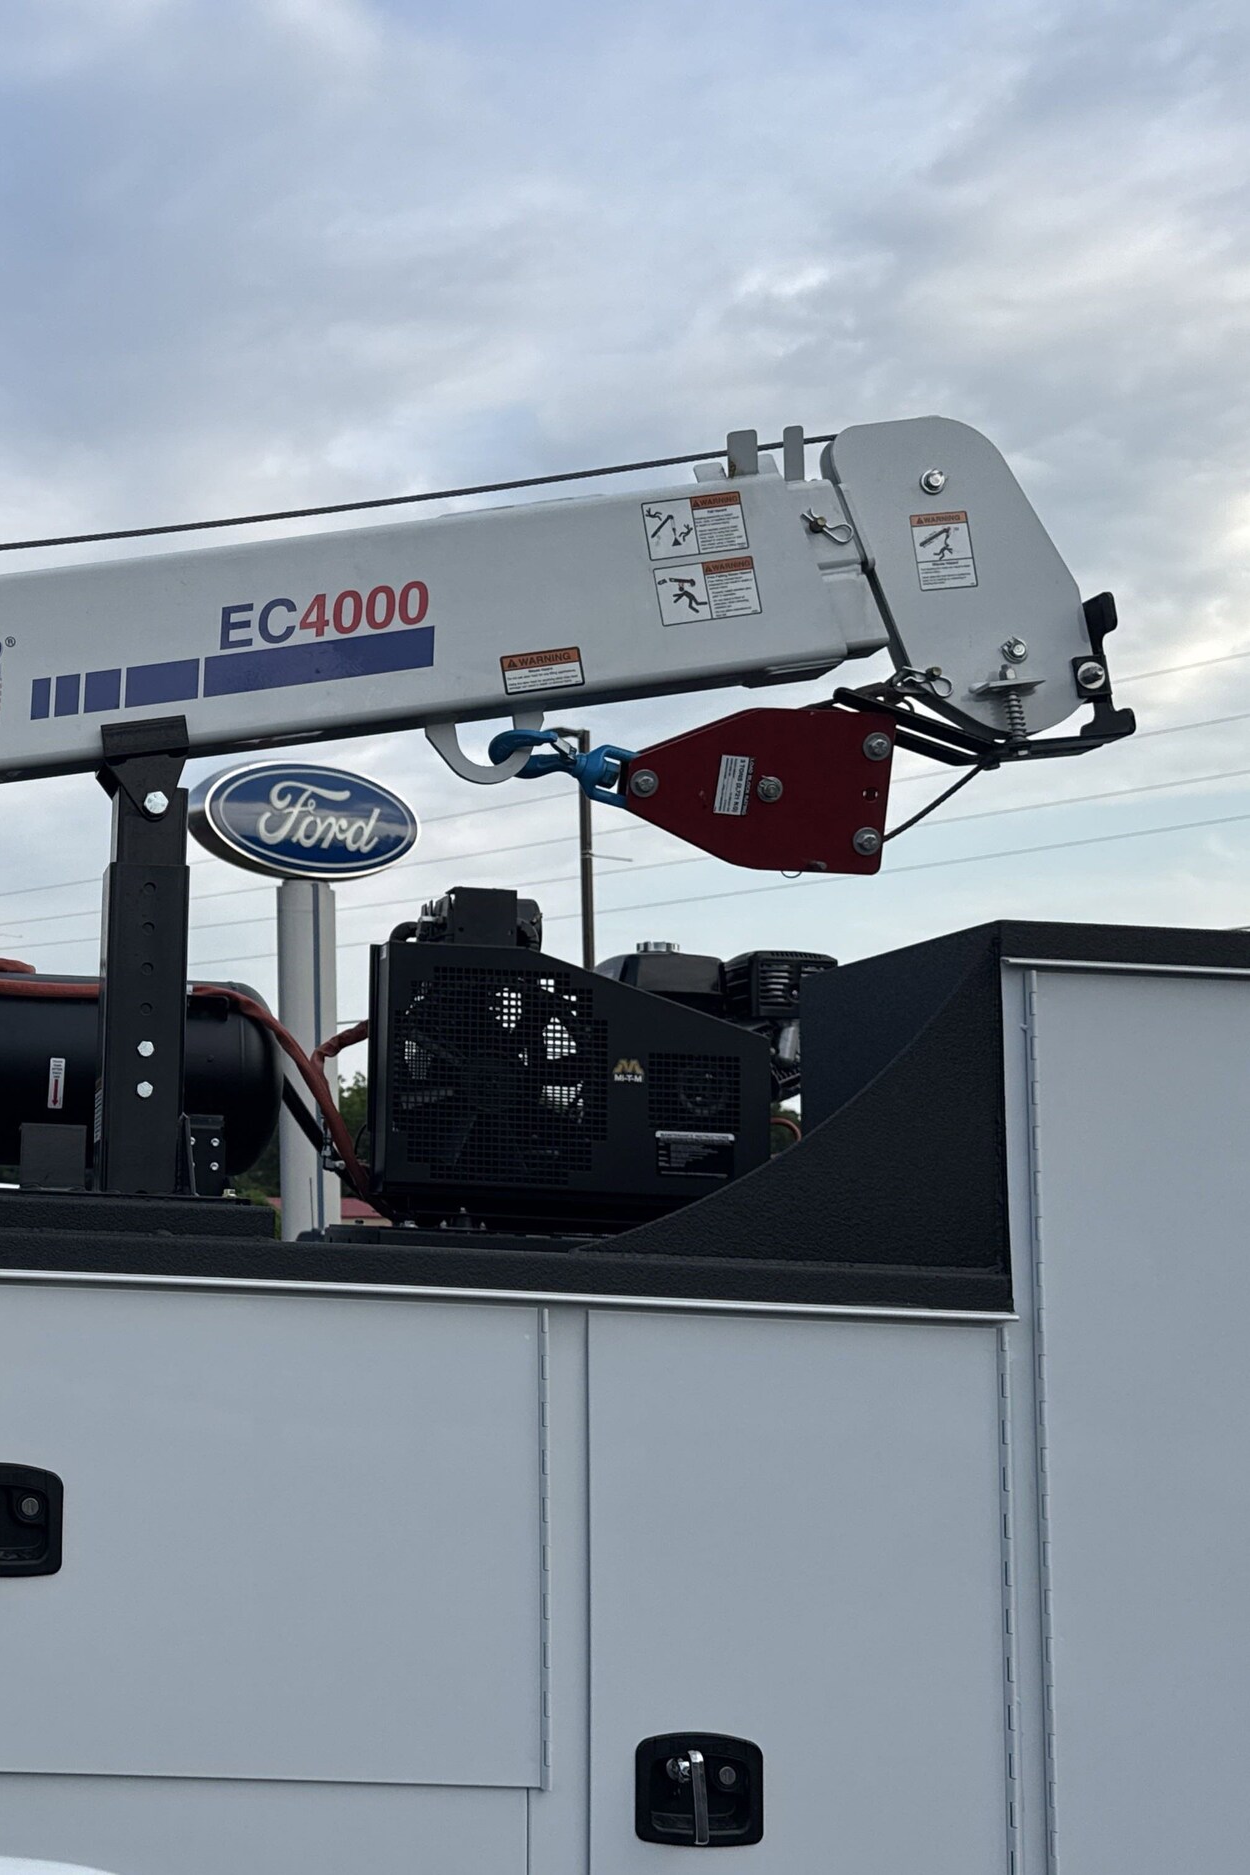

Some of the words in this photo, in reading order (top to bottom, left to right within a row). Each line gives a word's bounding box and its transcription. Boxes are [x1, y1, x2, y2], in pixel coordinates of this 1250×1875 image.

[700, 496, 737, 506] WARNING
[923, 515, 960, 524] WARNING
[220, 581, 429, 650] EC4000
[519, 652, 571, 666] WARNING
[259, 781, 380, 854] Ford
